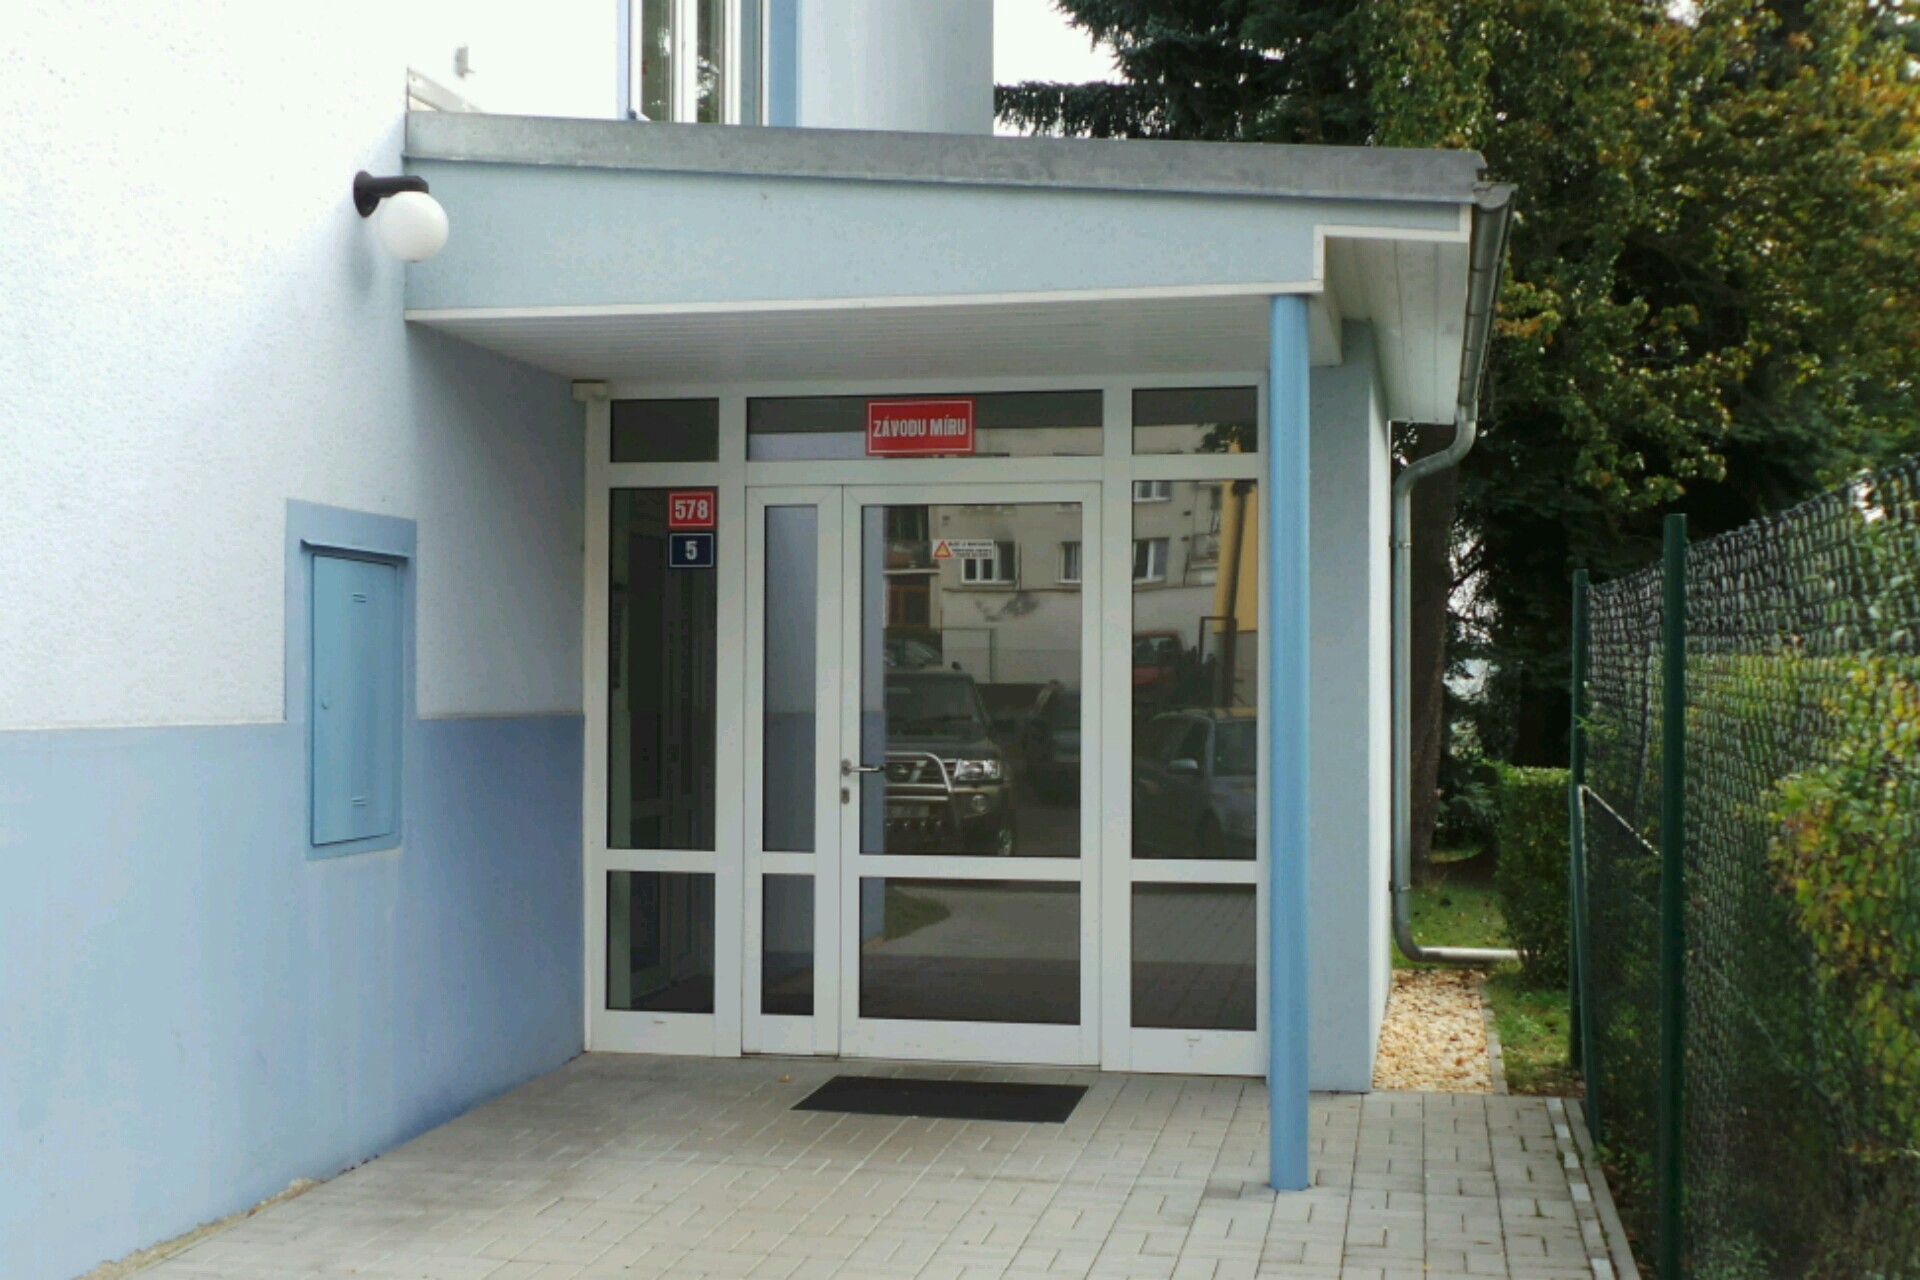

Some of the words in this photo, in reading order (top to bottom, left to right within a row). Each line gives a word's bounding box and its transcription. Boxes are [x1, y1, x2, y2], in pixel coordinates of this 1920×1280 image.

[872, 414, 927, 438] ZÁVODU
[930, 413, 967, 437] MÍRU
[674, 499, 709, 520] 578
[684, 540, 698, 560] 5
